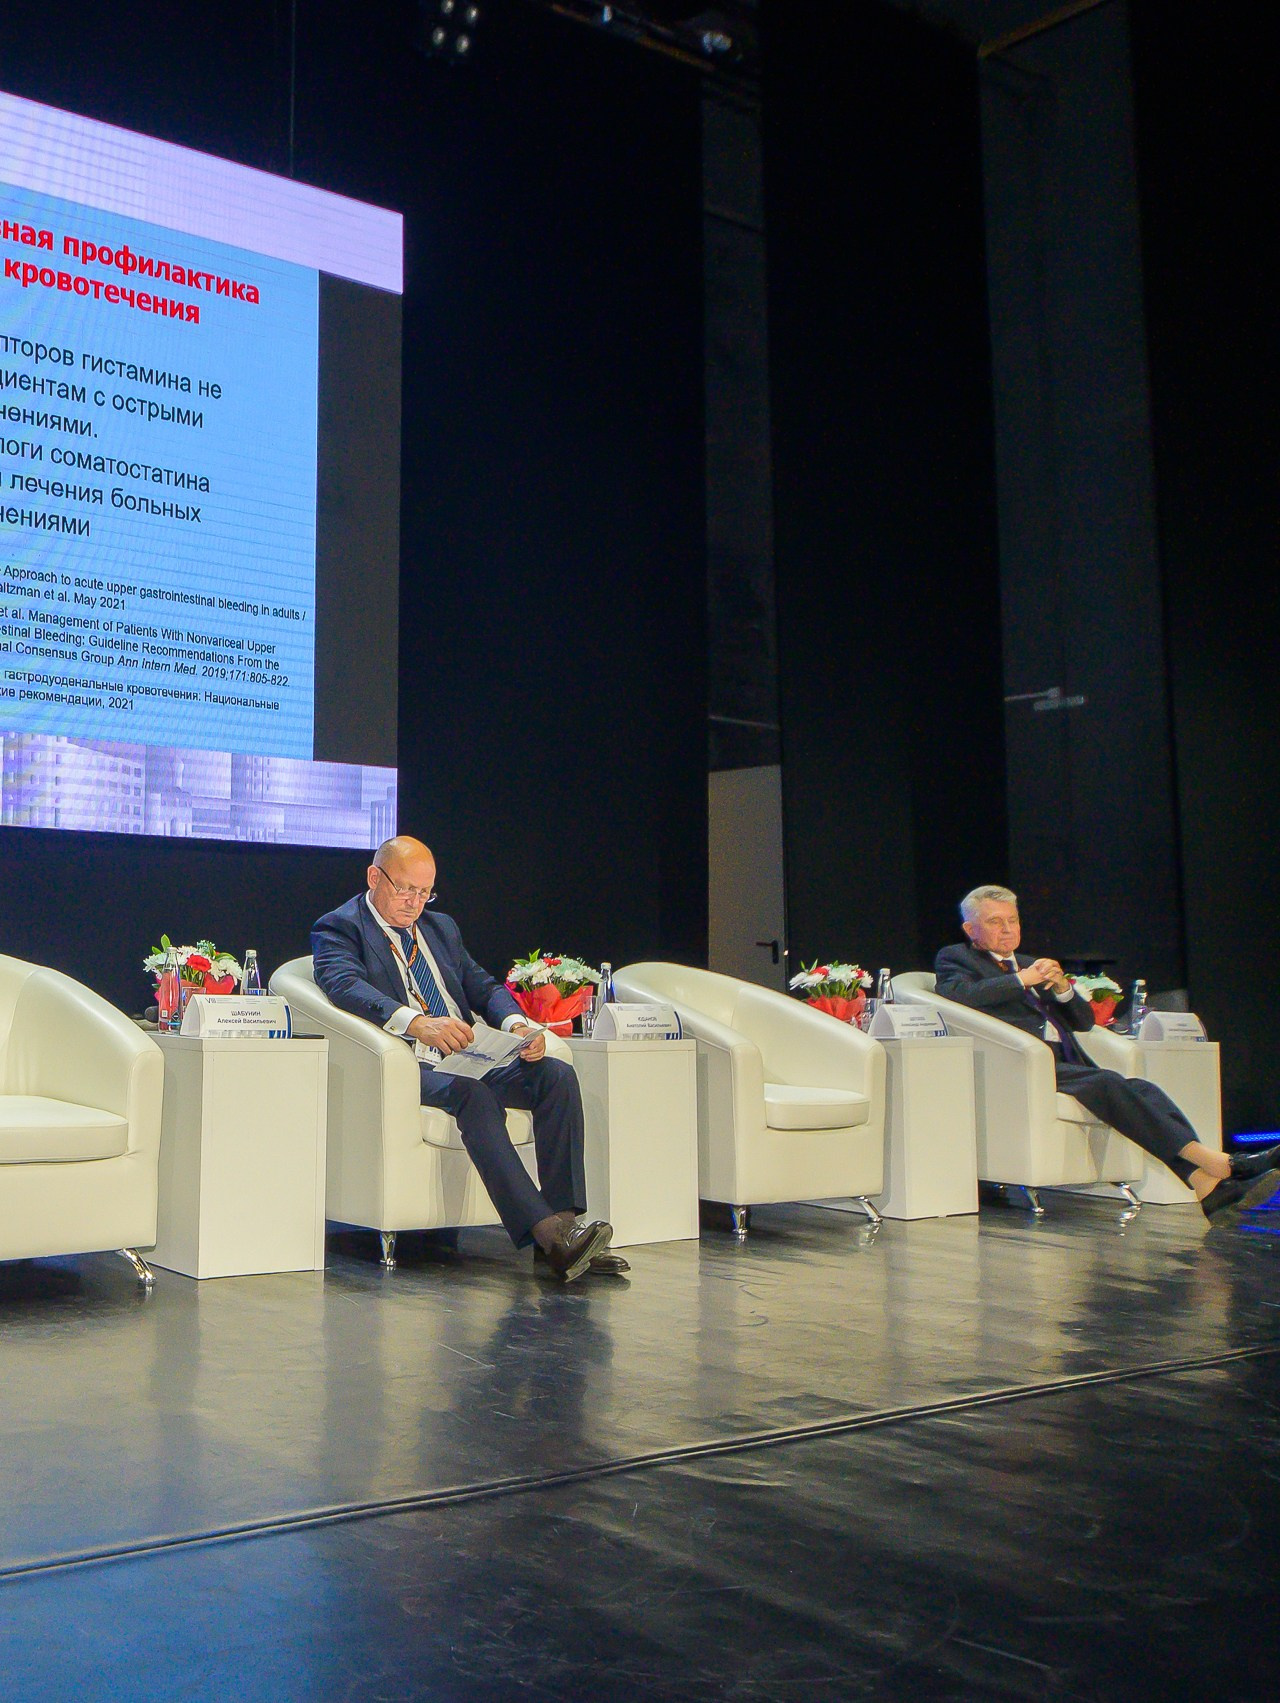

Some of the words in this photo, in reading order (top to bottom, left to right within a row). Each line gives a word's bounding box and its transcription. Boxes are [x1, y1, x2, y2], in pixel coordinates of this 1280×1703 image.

[4, 258, 200, 324] кровотечения
[63, 236, 260, 304] профилактика
[82, 353, 191, 393] гистамина
[198, 380, 222, 400] не
[93, 390, 106, 407] с
[112, 394, 203, 428] острыми
[50, 447, 210, 493] соматостатина
[9, 474, 103, 504] лечения
[111, 487, 202, 523] больных
[3, 565, 57, 584] Approach
[61, 573, 71, 585] to
[74, 577, 104, 590] acute
[107, 582, 137, 597] upper
[140, 587, 215, 608] gastrointestinal
[218, 597, 259, 616] bleeding
[261, 604, 270, 616] in
[272, 606, 300, 621] adults
[43, 588, 55, 600] et
[57, 590, 70, 603] al.
[74, 592, 96, 609] May
[99, 597, 126, 611] 2021
[11, 607, 25, 620] al.
[28, 609, 100, 630] Management
[102, 619, 113, 632] of
[116, 621, 158, 638] Patients
[161, 628, 184, 642] With
[186, 632, 244, 650] Nonvariceal
[247, 639, 276, 655] Upper
[34, 628, 85, 647] Bleeding:
[88, 634, 139, 652] Guideline
[142, 642, 235, 665] Recommendations
[237, 655, 262, 670] From
[265, 658, 280, 671] the
[15, 642, 78, 660] Consensus
[81, 650, 114, 667] Group
[117, 655, 139, 668] Ann
[142, 658, 171, 672] Intern
[174, 662, 198, 676] Med.
[4, 670, 124, 692] гастродуоденальные
[126, 683, 201, 702] кровотечения:
[204, 691, 280, 711] Национальные
[18, 688, 105, 709] рекомендации,
[108, 697, 134, 711] 2021
